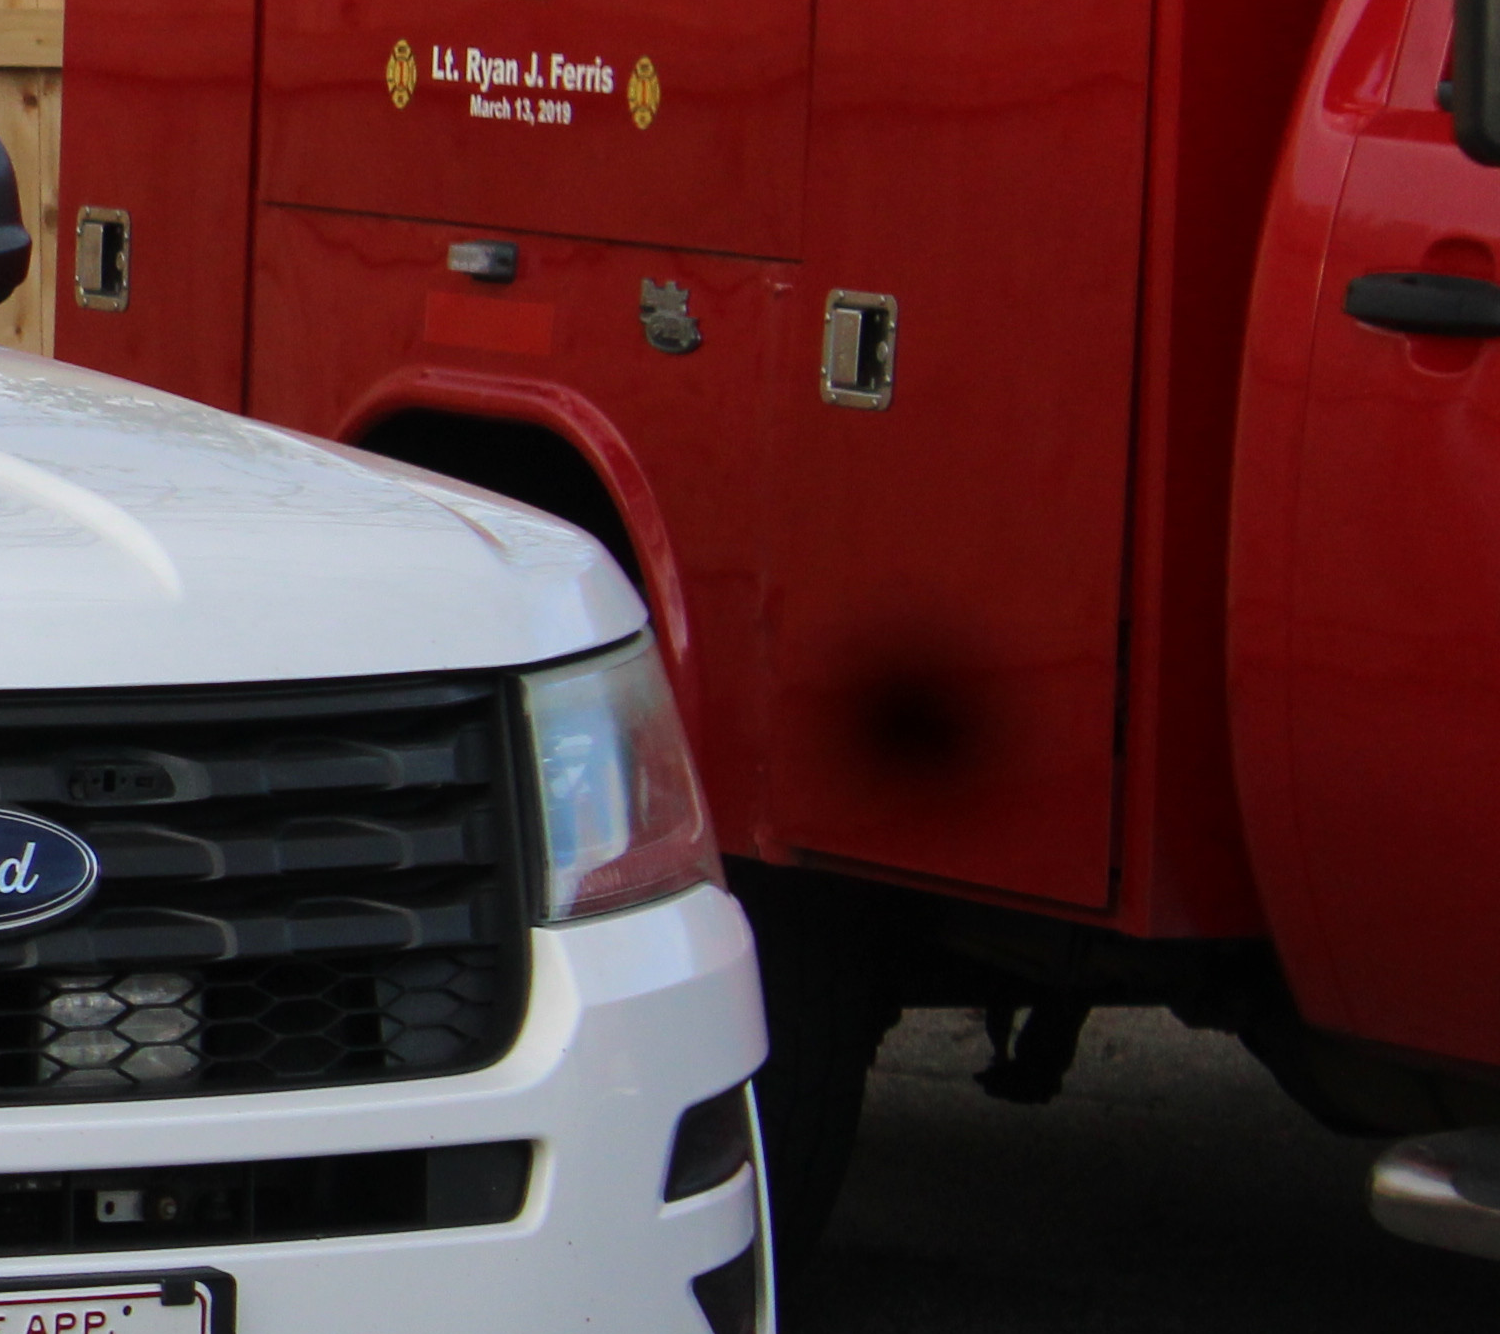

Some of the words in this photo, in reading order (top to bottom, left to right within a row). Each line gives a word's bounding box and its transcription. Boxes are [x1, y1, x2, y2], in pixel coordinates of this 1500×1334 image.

[432, 45, 459, 82] Lt.
[466, 47, 519, 93] Ryan
[524, 51, 544, 88] J.
[550, 52, 615, 94] Ferris
[470, 94, 511, 120] March
[515, 96, 535, 126] 13,
[537, 99, 572, 125] 2019
